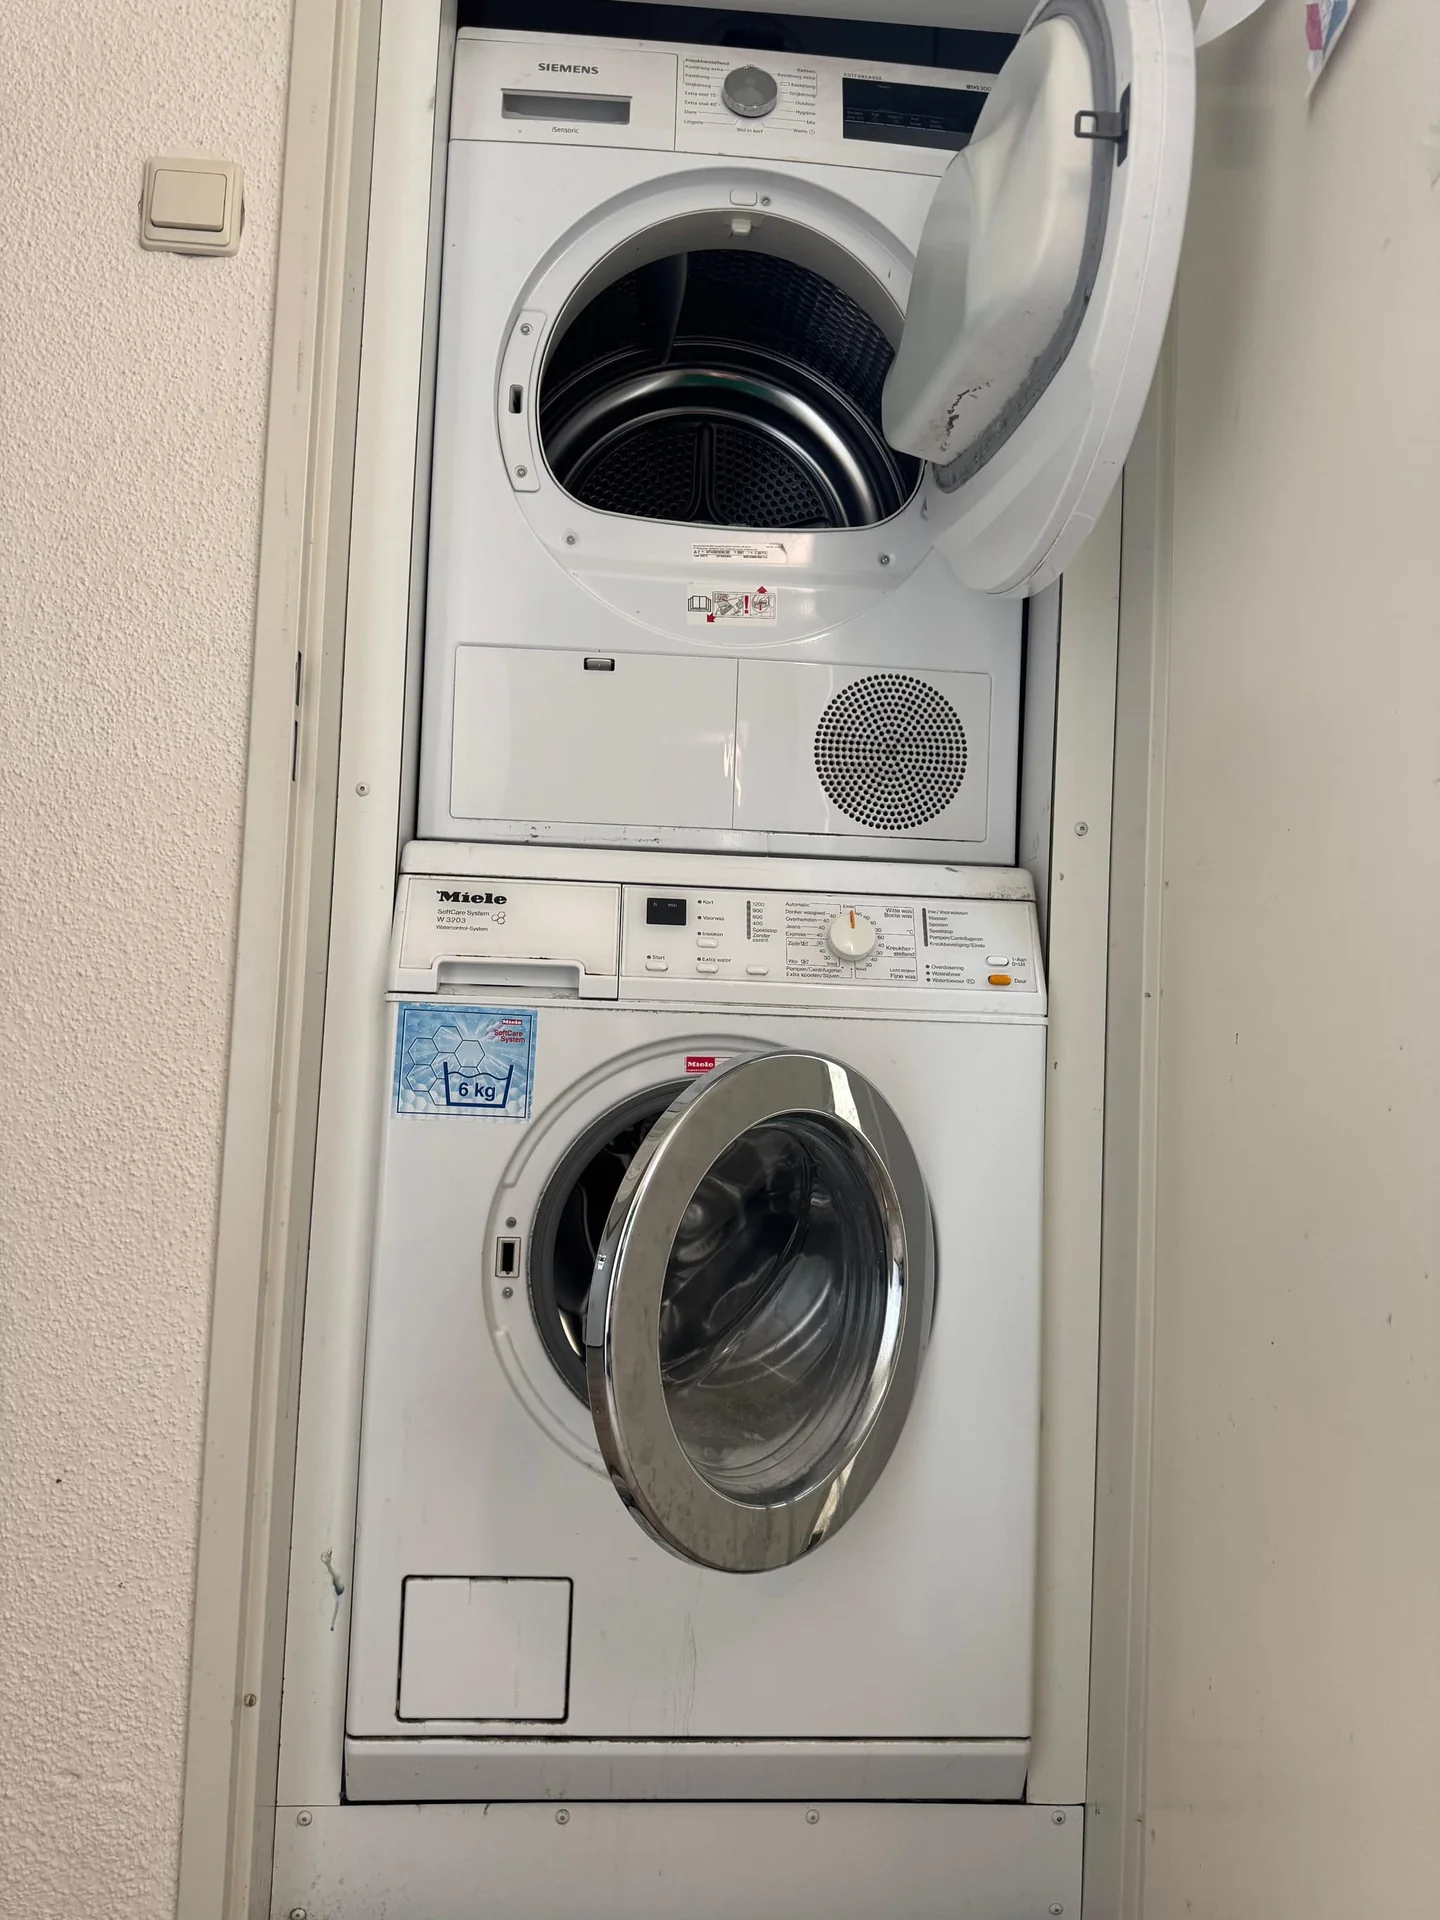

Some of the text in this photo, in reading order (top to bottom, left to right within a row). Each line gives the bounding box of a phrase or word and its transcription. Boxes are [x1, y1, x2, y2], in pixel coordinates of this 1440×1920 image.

[538, 62, 599, 74] SIEMENS
[436, 890, 507, 904] Miele
[458, 1082, 496, 1101] 6 kg
